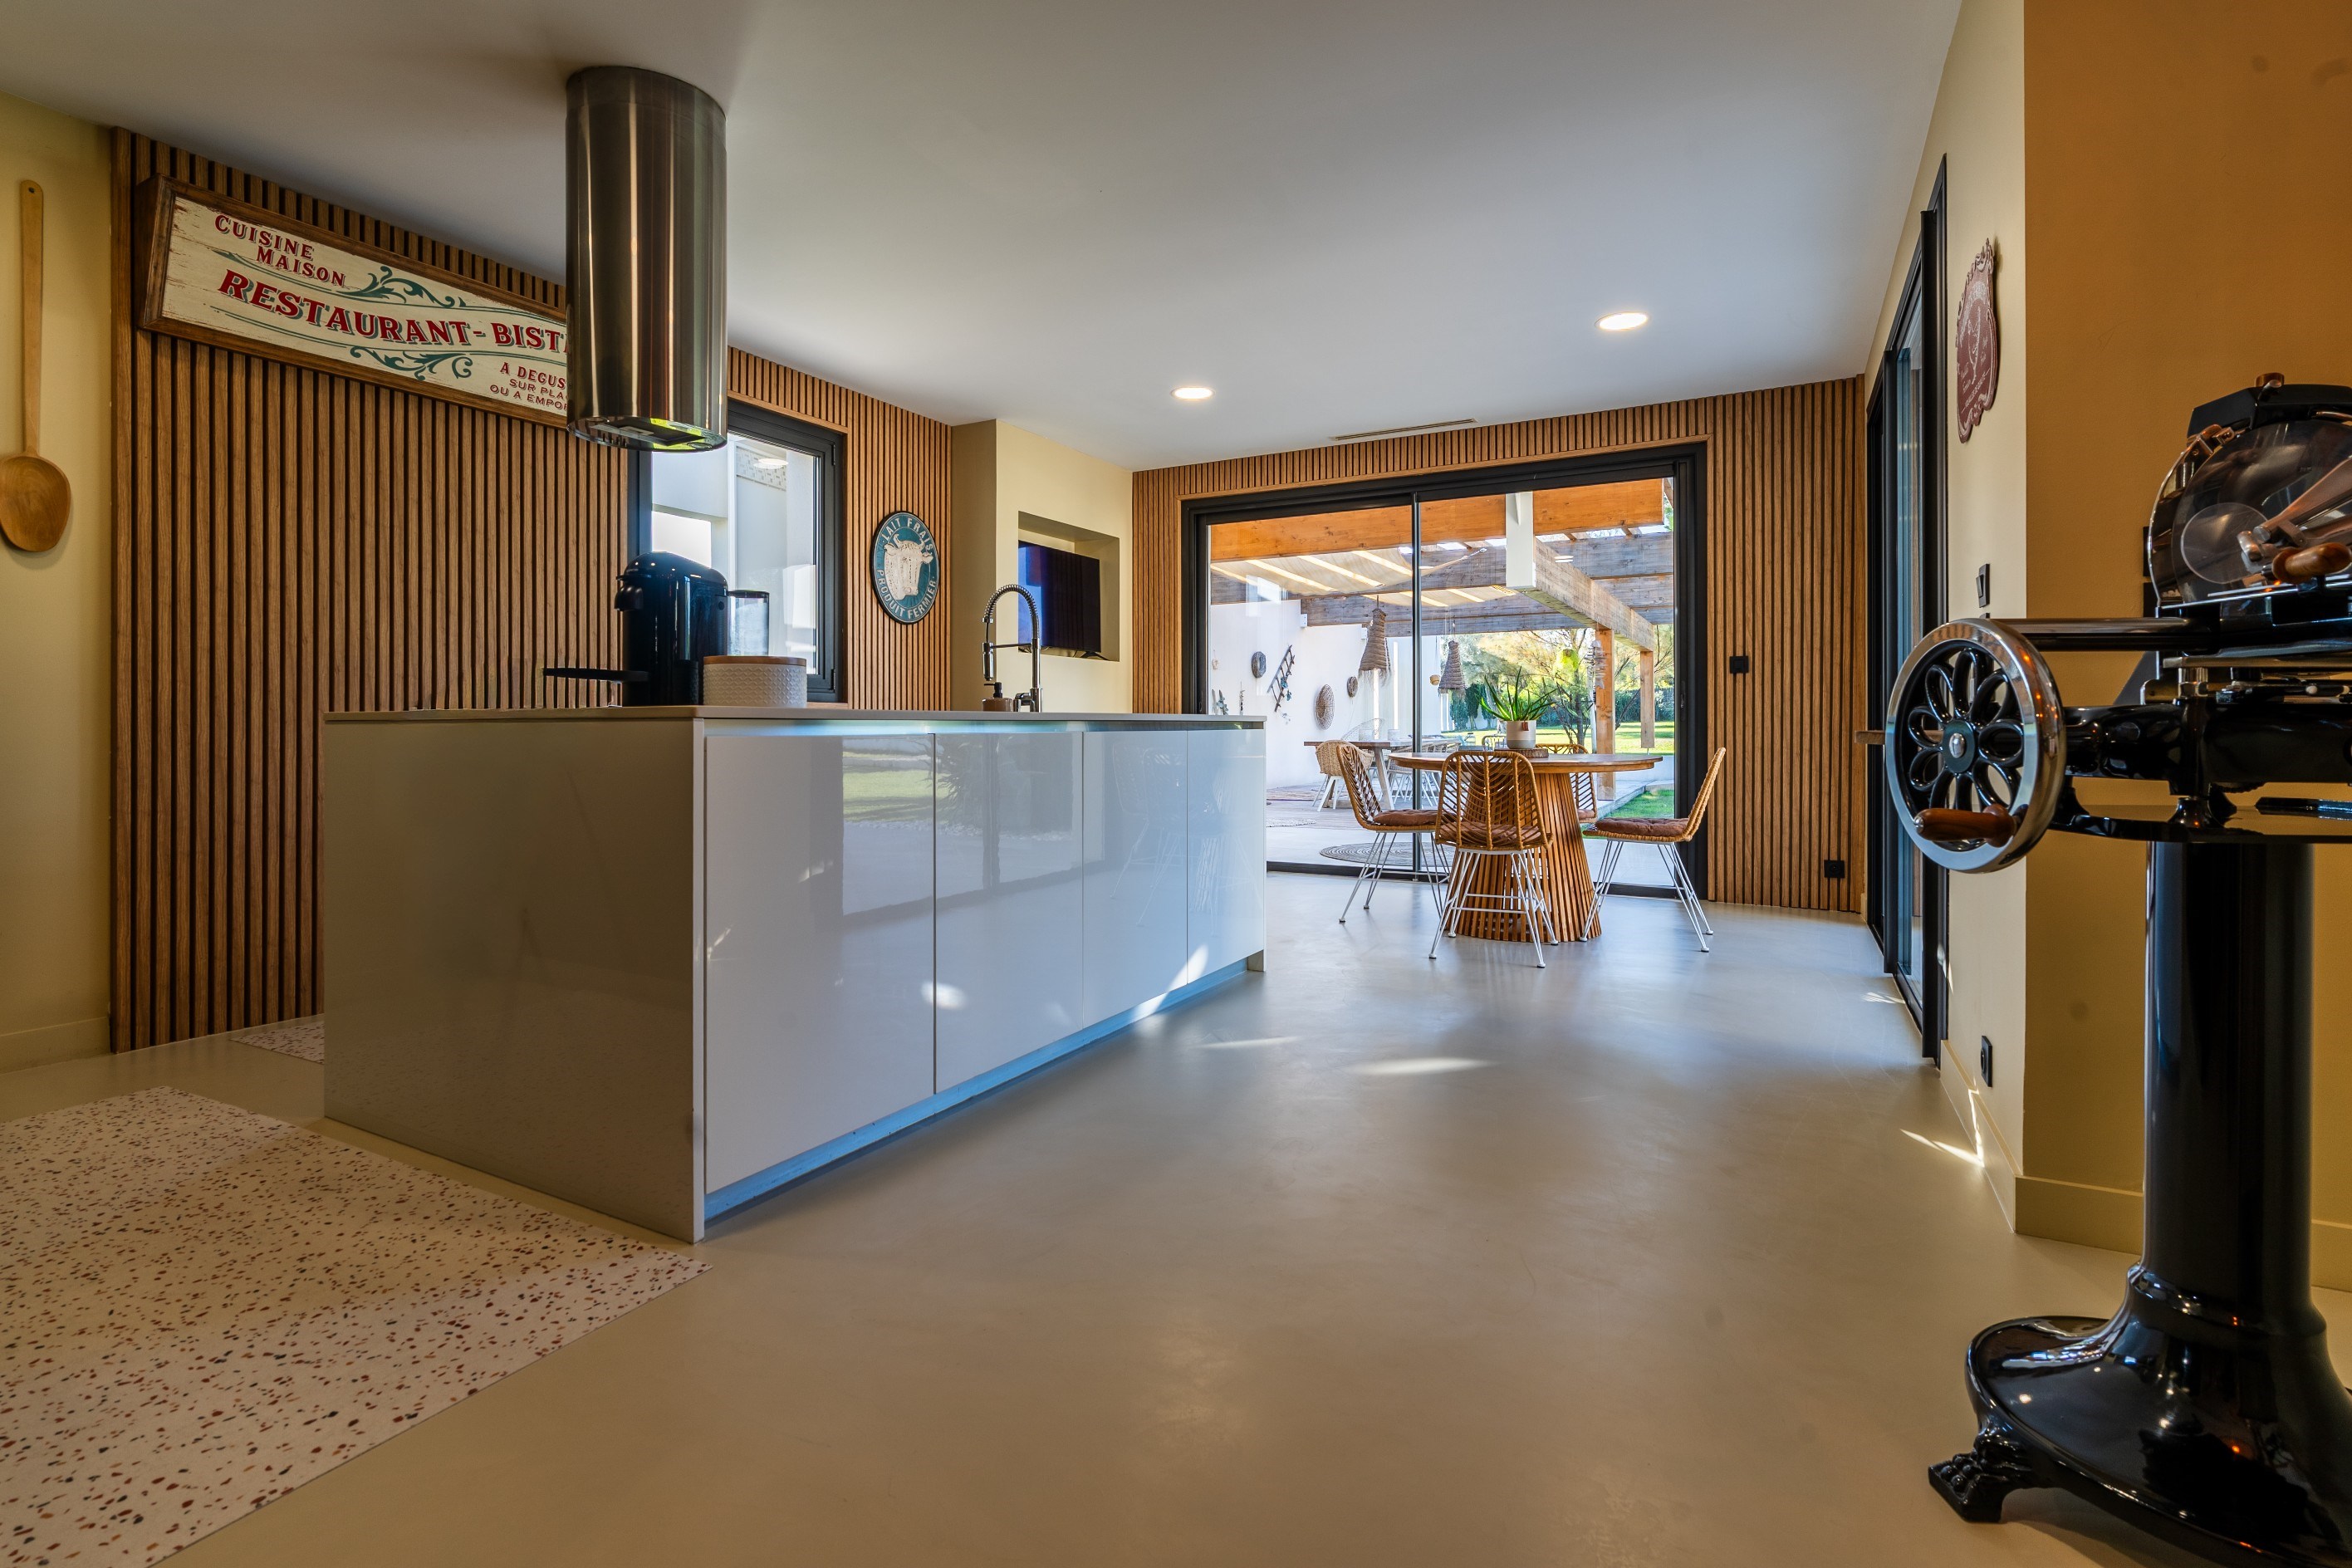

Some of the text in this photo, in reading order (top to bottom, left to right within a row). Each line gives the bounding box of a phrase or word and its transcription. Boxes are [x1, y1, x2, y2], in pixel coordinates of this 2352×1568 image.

[215, 214, 314, 260] CUISINE
[257, 246, 345, 287] MAISON
[491, 322, 568, 353] BIST
[500, 361, 510, 375] A
[490, 385, 509, 397] OU
[513, 390, 522, 399] A
[509, 379, 568, 400] SUR PLA
[881, 517, 933, 551] LAIT FRAIS
[876, 569, 937, 620] PRODUIT FERMIER
